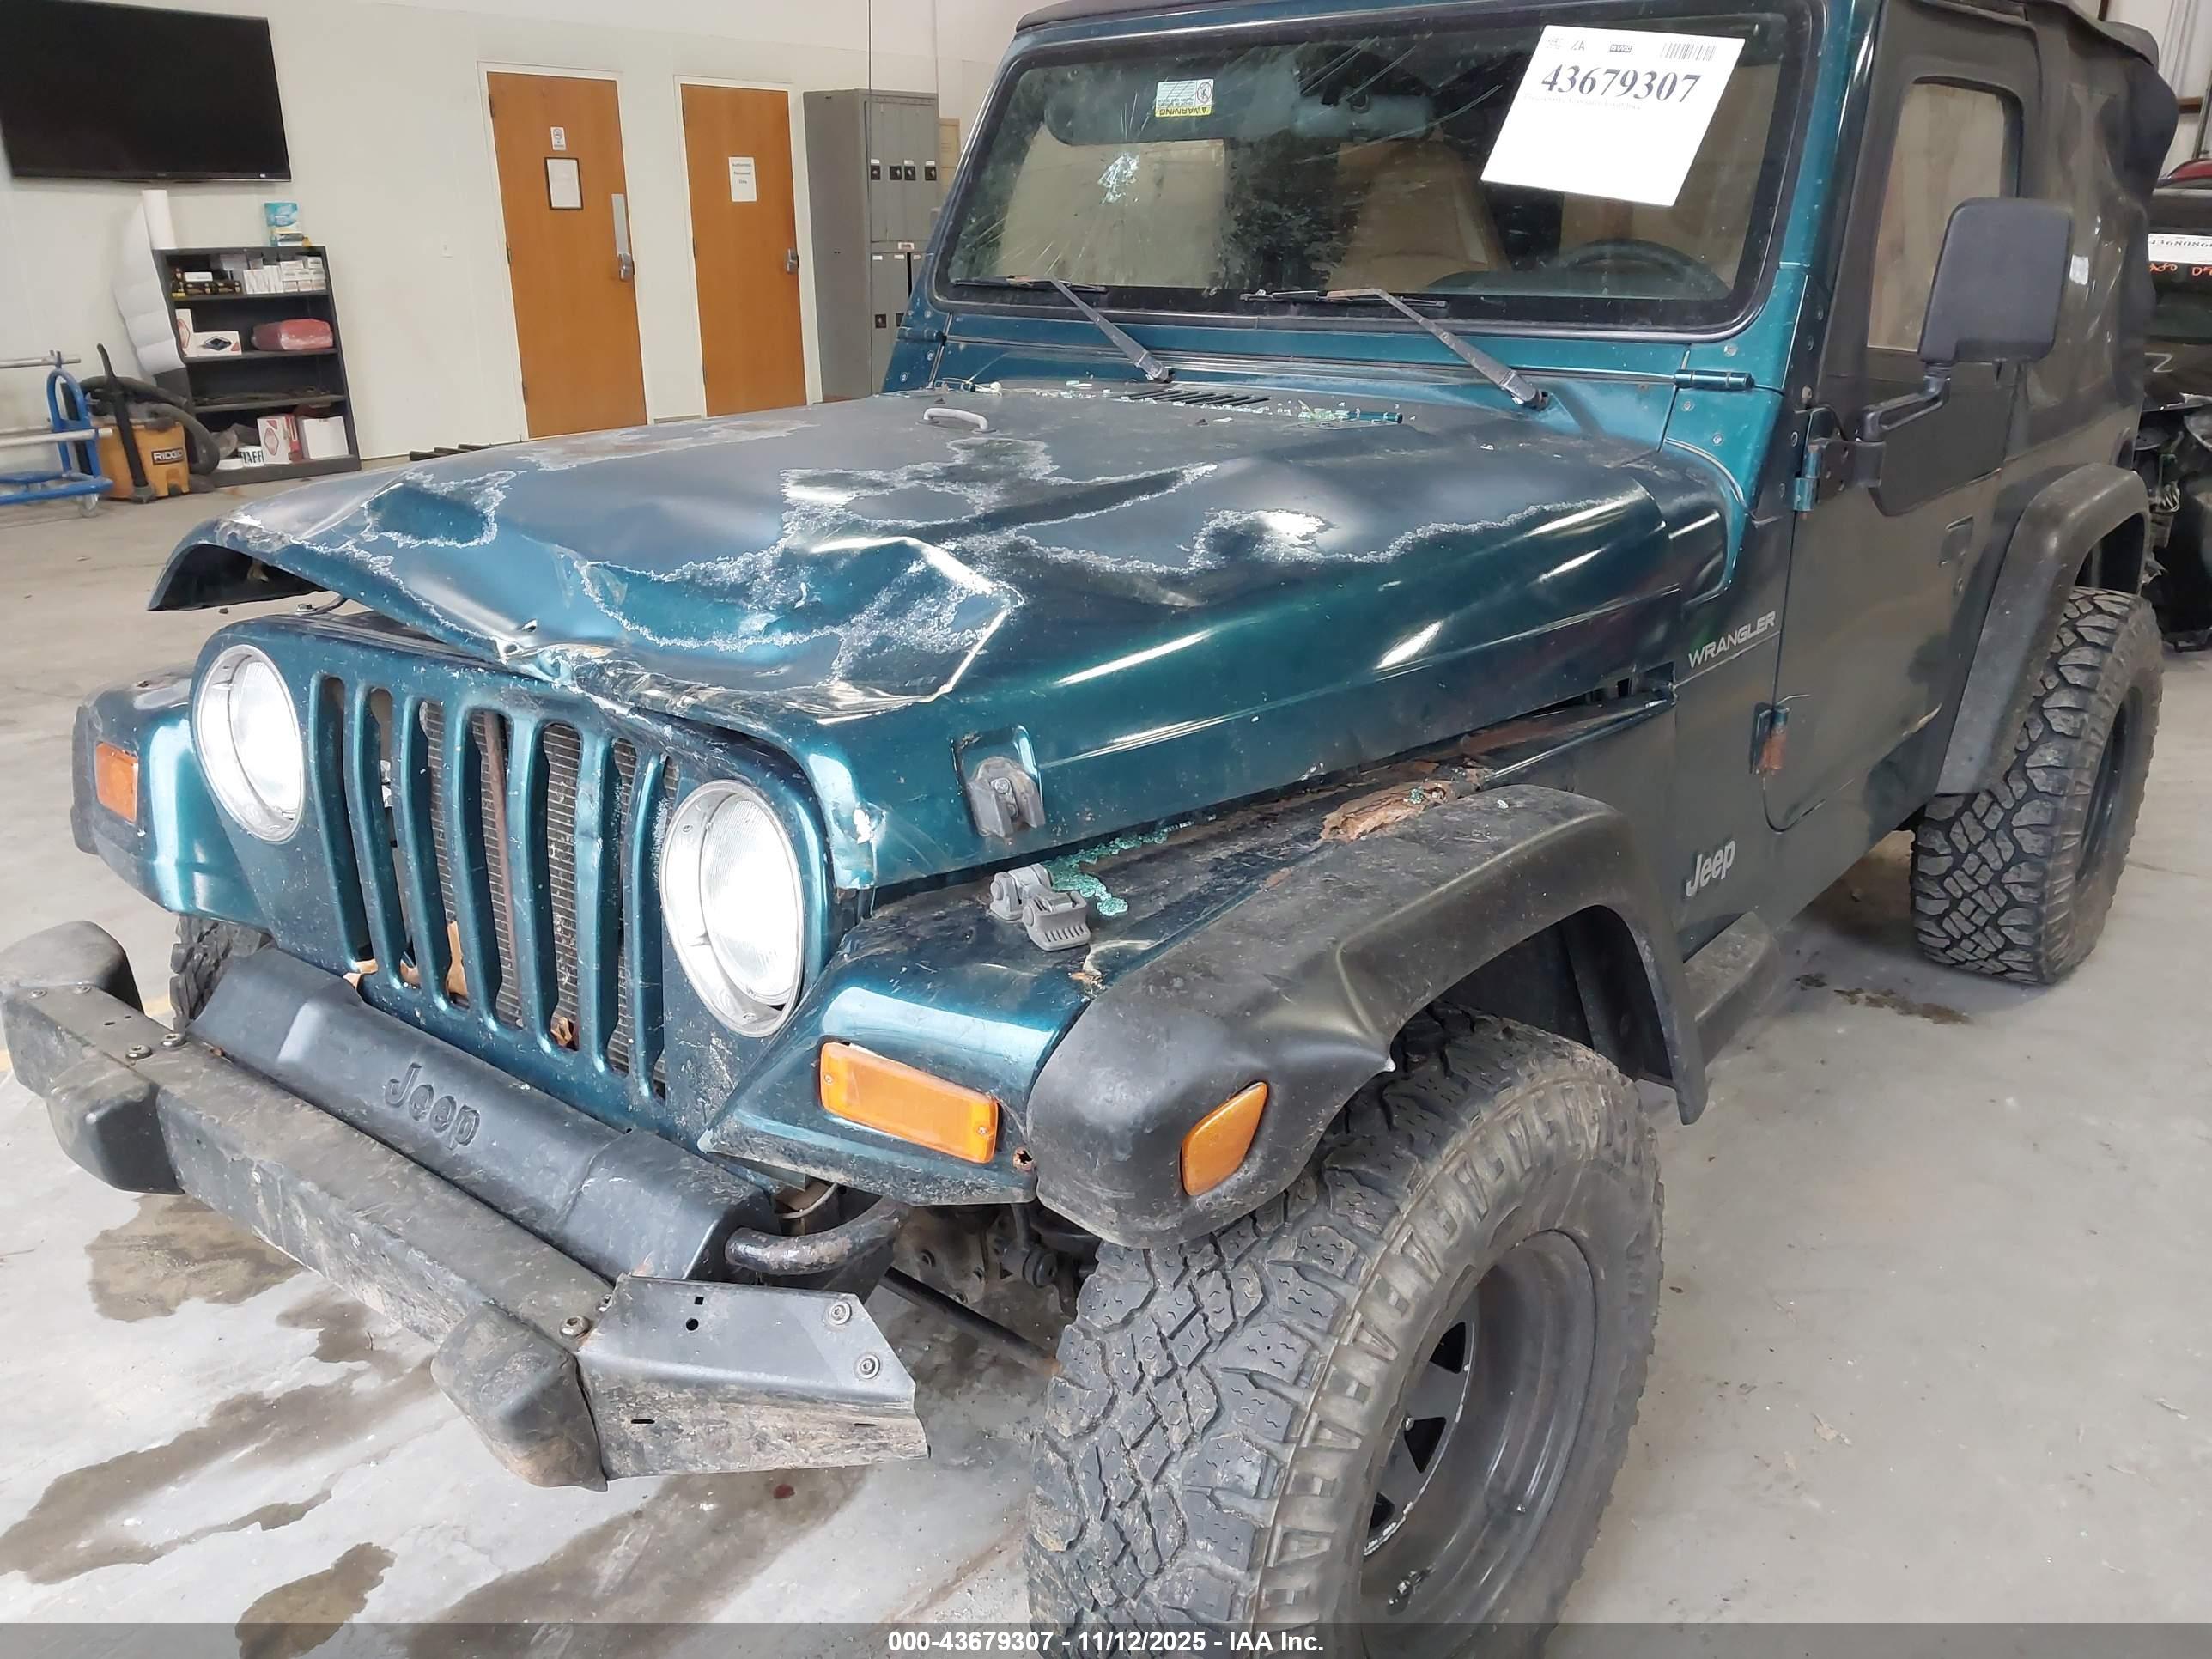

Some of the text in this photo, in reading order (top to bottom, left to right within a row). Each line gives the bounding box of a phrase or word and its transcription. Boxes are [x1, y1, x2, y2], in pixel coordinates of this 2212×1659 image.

[1541, 64, 1702, 103] 43679307
[1688, 611, 1776, 669] WRANGLER
[1686, 839, 1736, 897] Jeep
[385, 1061, 481, 1152] Jeep
